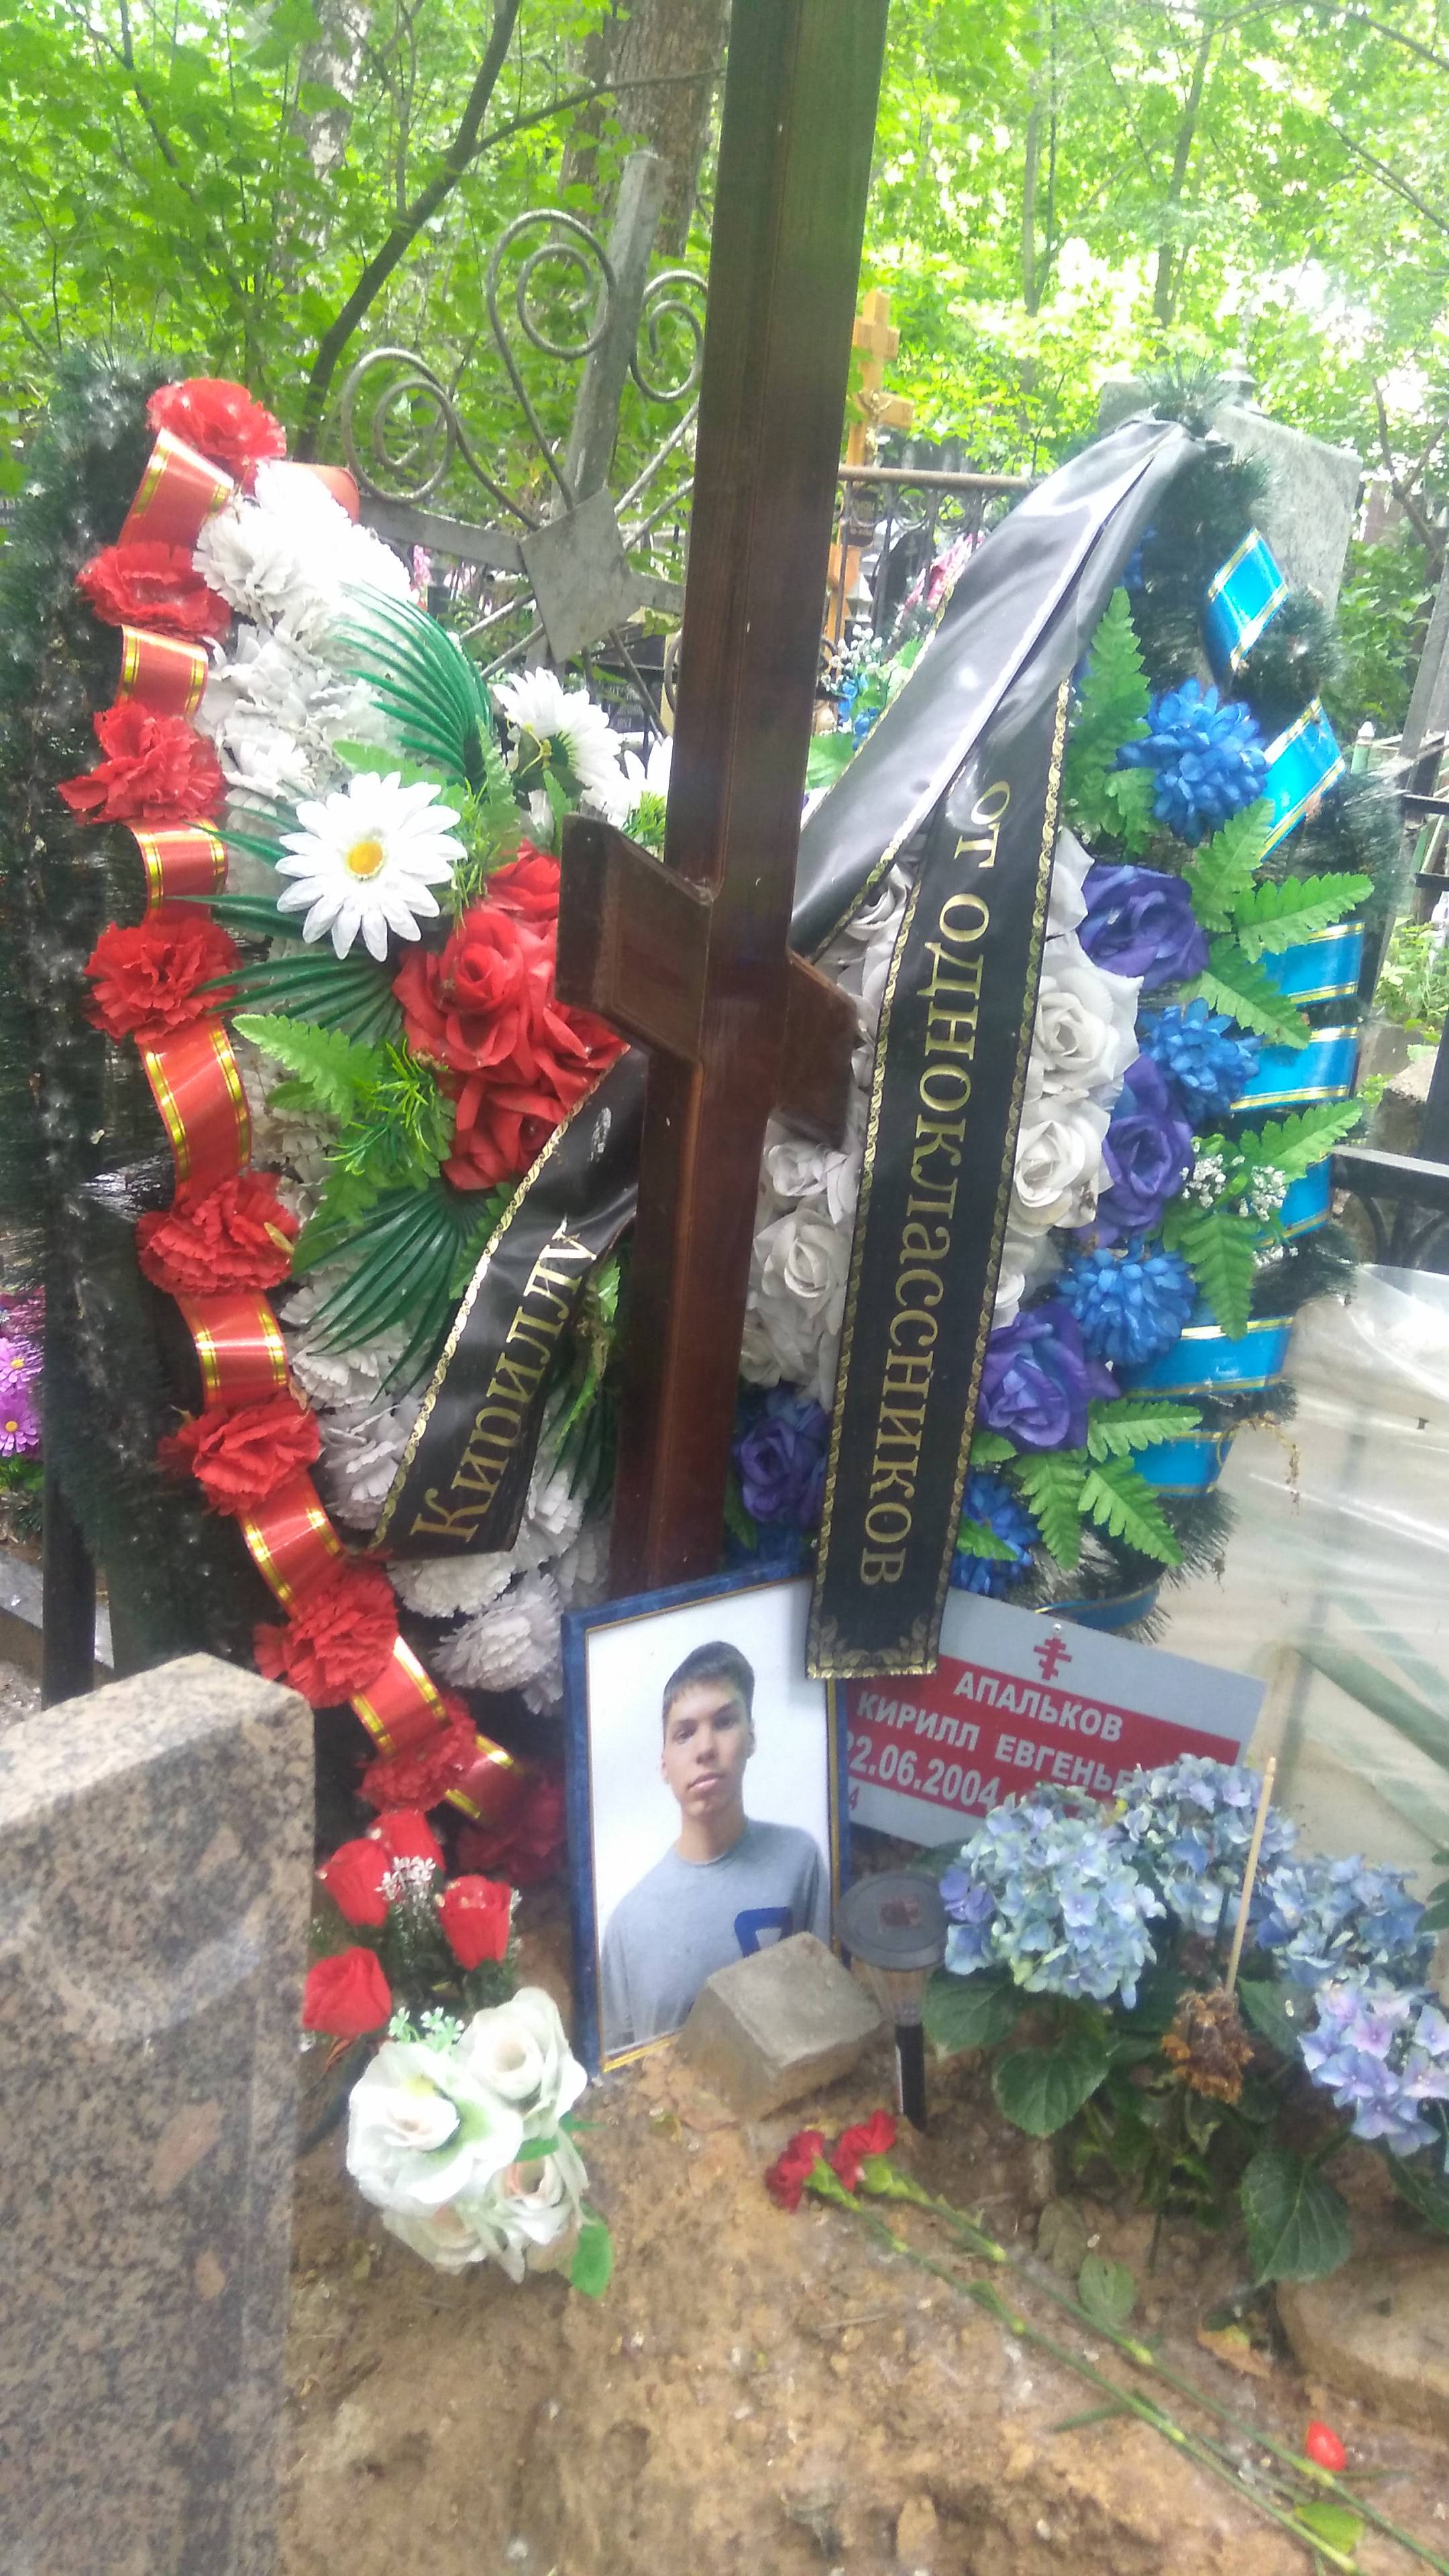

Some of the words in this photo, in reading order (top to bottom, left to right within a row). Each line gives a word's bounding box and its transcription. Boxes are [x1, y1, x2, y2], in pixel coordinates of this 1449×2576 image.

[953, 780, 1010, 869] от
[859, 893, 990, 1587] одноклассников
[857, 1690, 981, 1753] КИРИЛЛ
[953, 1670, 1123, 1742] АПАЛЬКОВ
